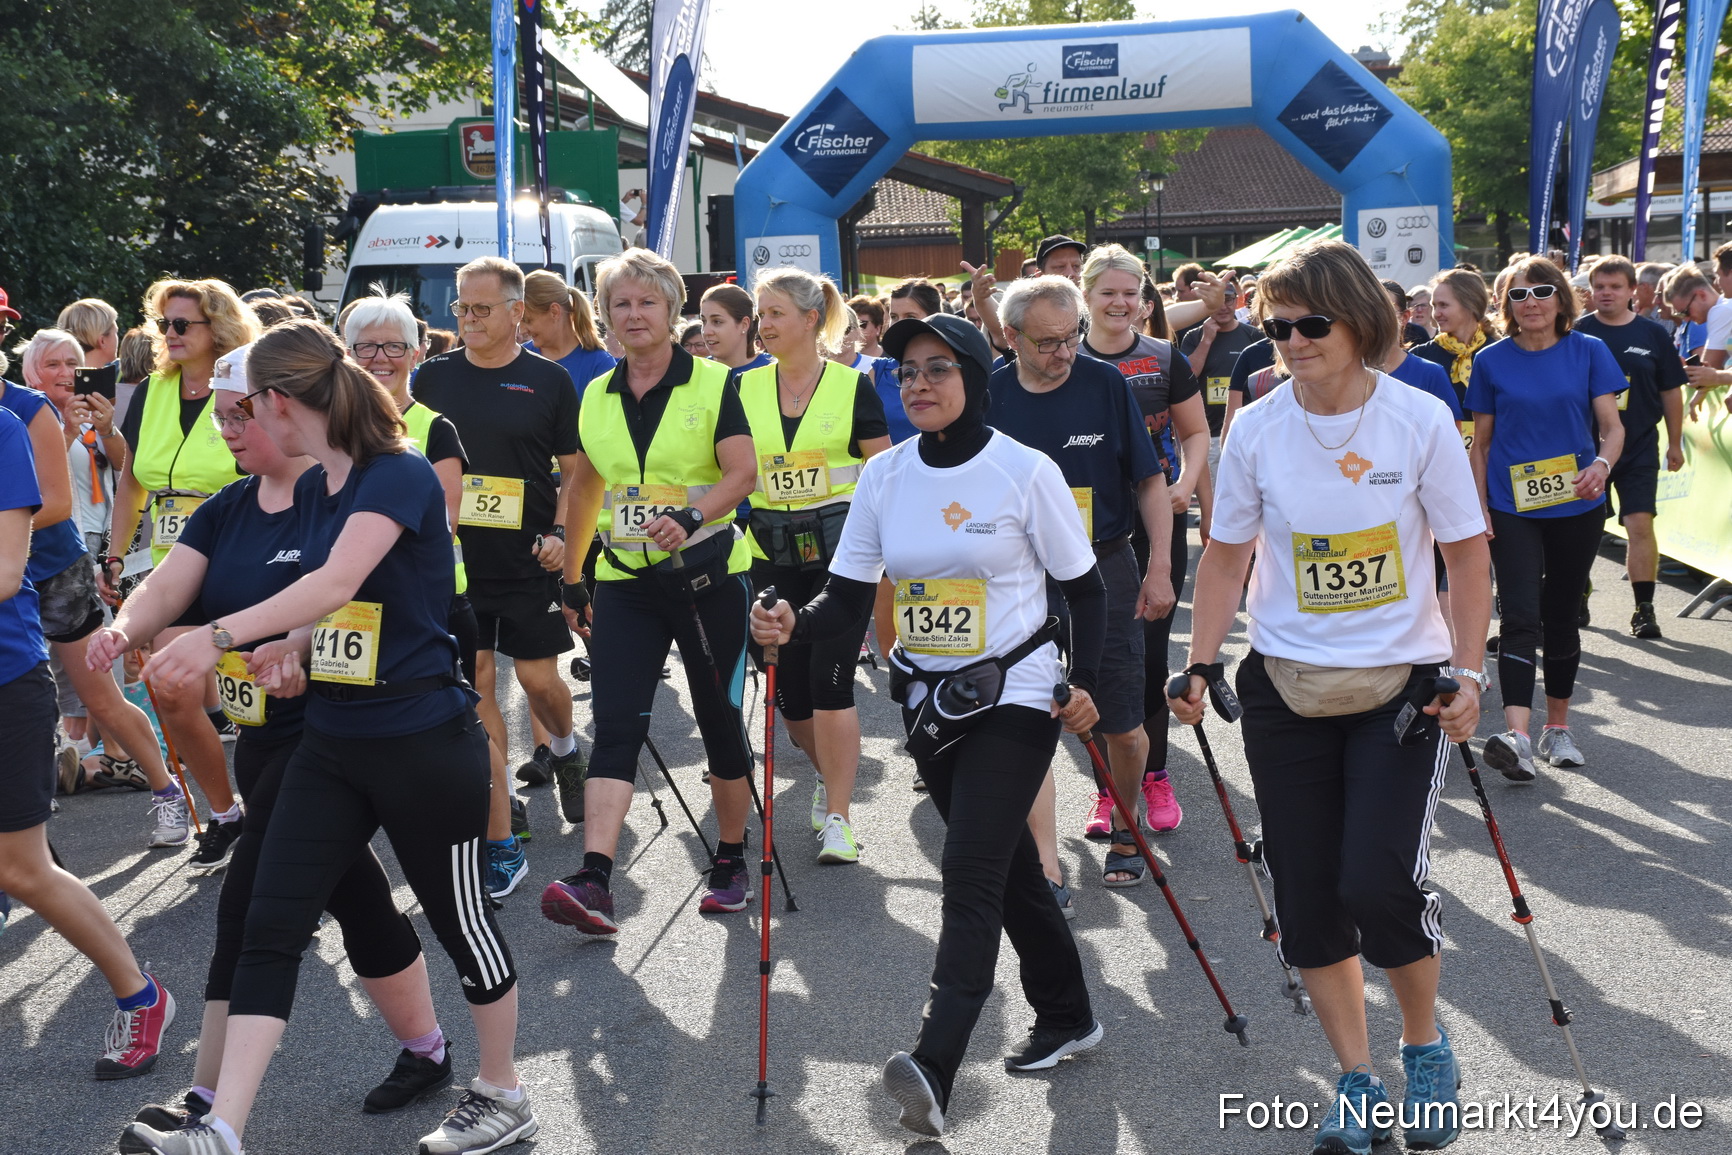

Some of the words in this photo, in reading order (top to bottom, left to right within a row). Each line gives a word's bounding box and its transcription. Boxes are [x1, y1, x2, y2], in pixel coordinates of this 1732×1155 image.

[1074, 54, 1115, 67] Fischer
[1043, 75, 1167, 103] firmenlauf
[1043, 103, 1094, 113] neumarkt
[1301, 109, 1319, 120] und
[1321, 105, 1340, 116] das
[1325, 118, 1351, 131] fährt
[1353, 113, 1376, 123] mit!
[807, 134, 873, 149] Fischer
[814, 148, 868, 156] AUTOMOBILE
[368, 236, 420, 249] abavent
[771, 468, 819, 491] 1517
[1527, 475, 1564, 496] 863
[476, 495, 502, 514] 52
[1306, 548, 1348, 558] firmenlauf
[1353, 548, 1372, 559] walk
[1374, 544, 1393, 555] 2019
[1306, 554, 1387, 591] 1337
[904, 593, 939, 602] firmenlauf
[1303, 590, 1357, 601] Guttenberger
[1360, 581, 1398, 595] Marianne
[1308, 599, 1343, 607] Landratsamt
[1343, 596, 1372, 605] Neumarkt
[904, 606, 971, 634] 1342
[908, 634, 947, 642] Krause-Stini
[320, 659, 349, 668] Gabriela
[1216, 680, 1237, 706] LEKI
